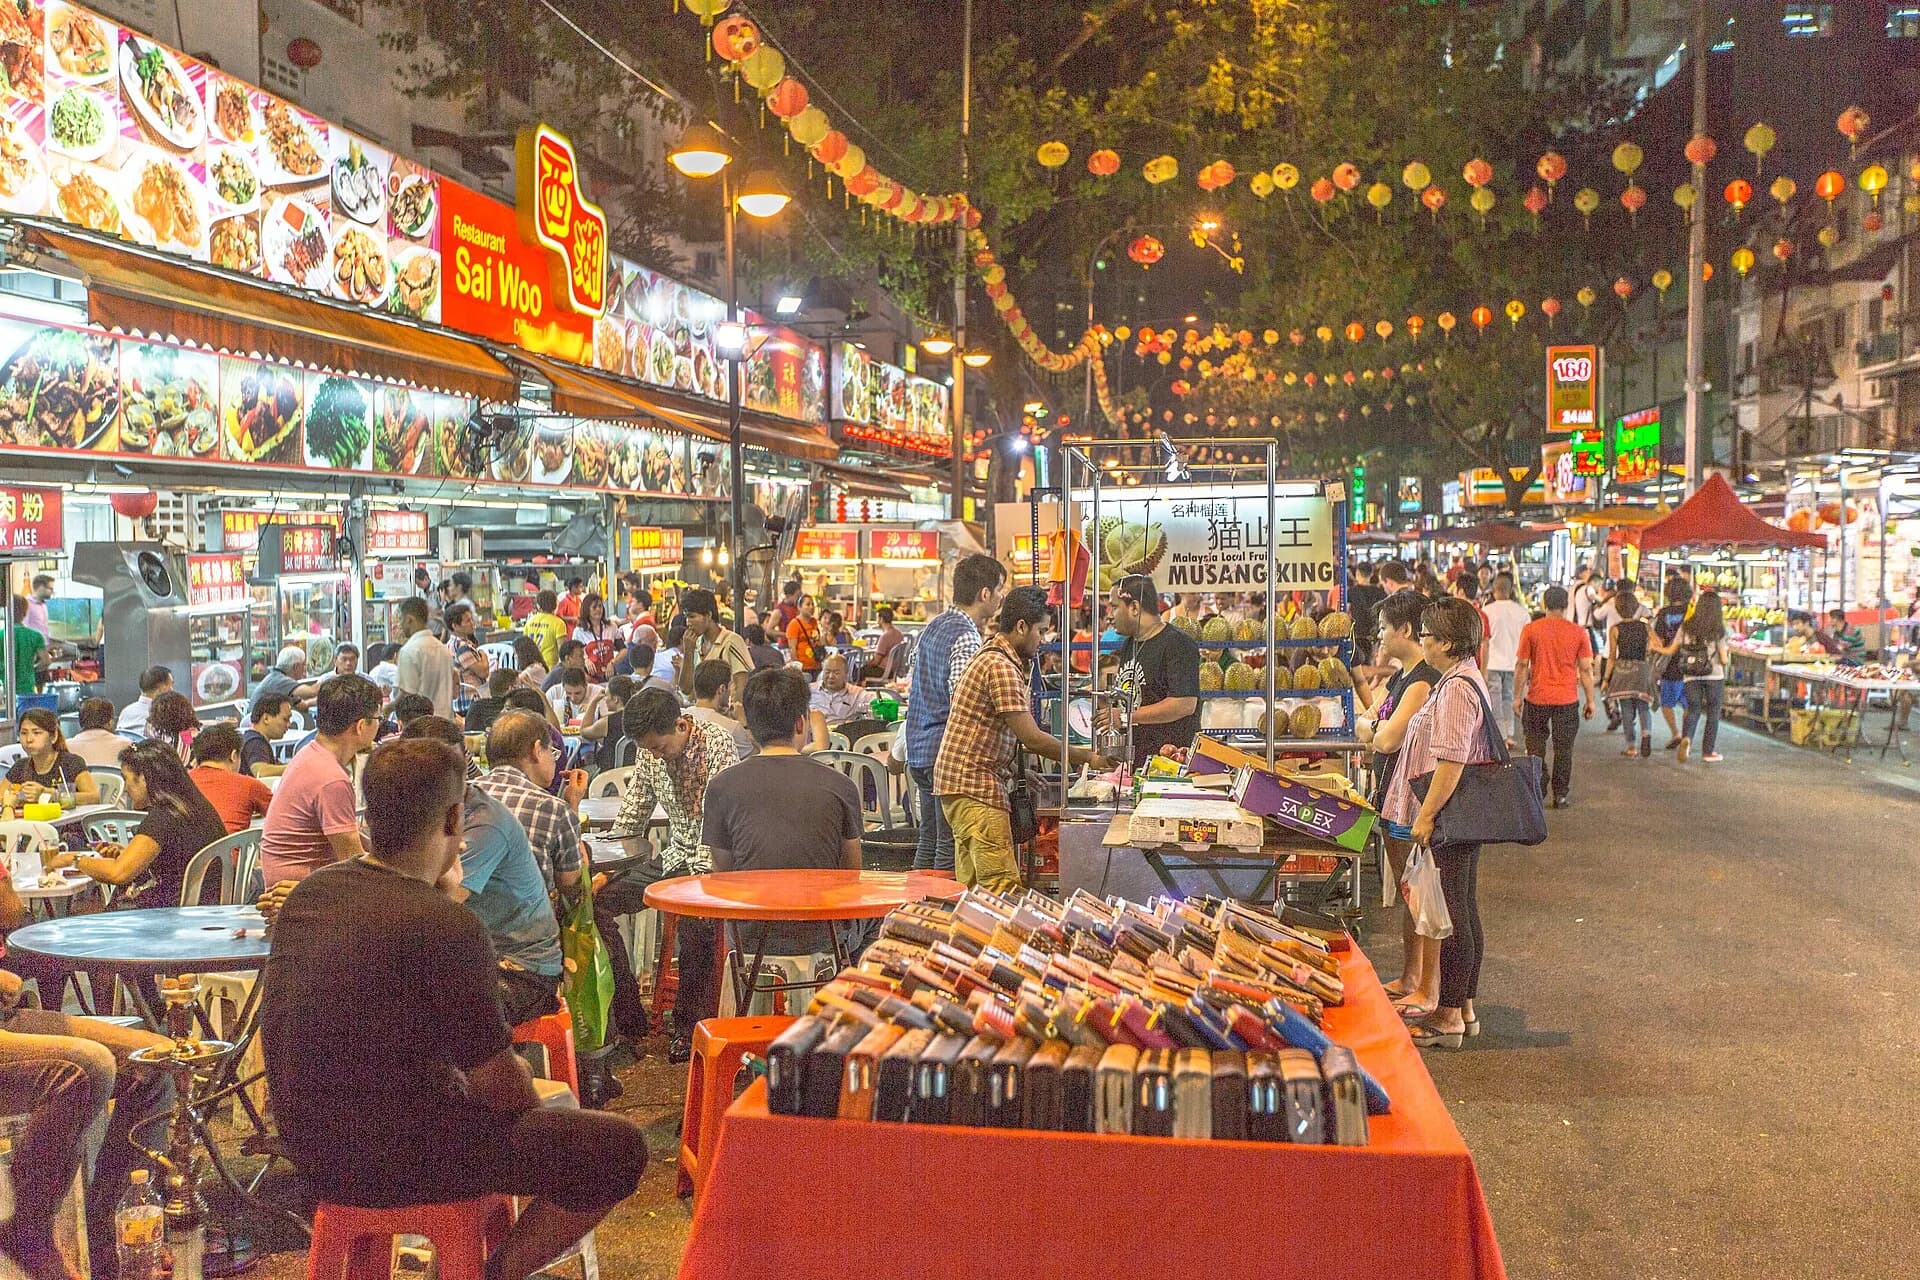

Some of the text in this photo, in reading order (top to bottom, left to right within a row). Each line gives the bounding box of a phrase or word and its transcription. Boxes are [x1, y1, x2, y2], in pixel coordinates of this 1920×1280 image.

[453, 214, 506, 254] Restaurant
[455, 246, 542, 317] Sai Woo
[1553, 358, 1592, 382] 168
[1171, 503, 1228, 518] 名种榴莲
[13, 527, 38, 546] MEE
[1207, 515, 1312, 551] 猫山王
[881, 545, 927, 559] SATAY
[1172, 552, 1218, 564] Malaysia
[1221, 551, 1246, 562] Local
[1168, 562, 1333, 585] MUSANG KING
[1280, 801, 1336, 830] SAPEX
